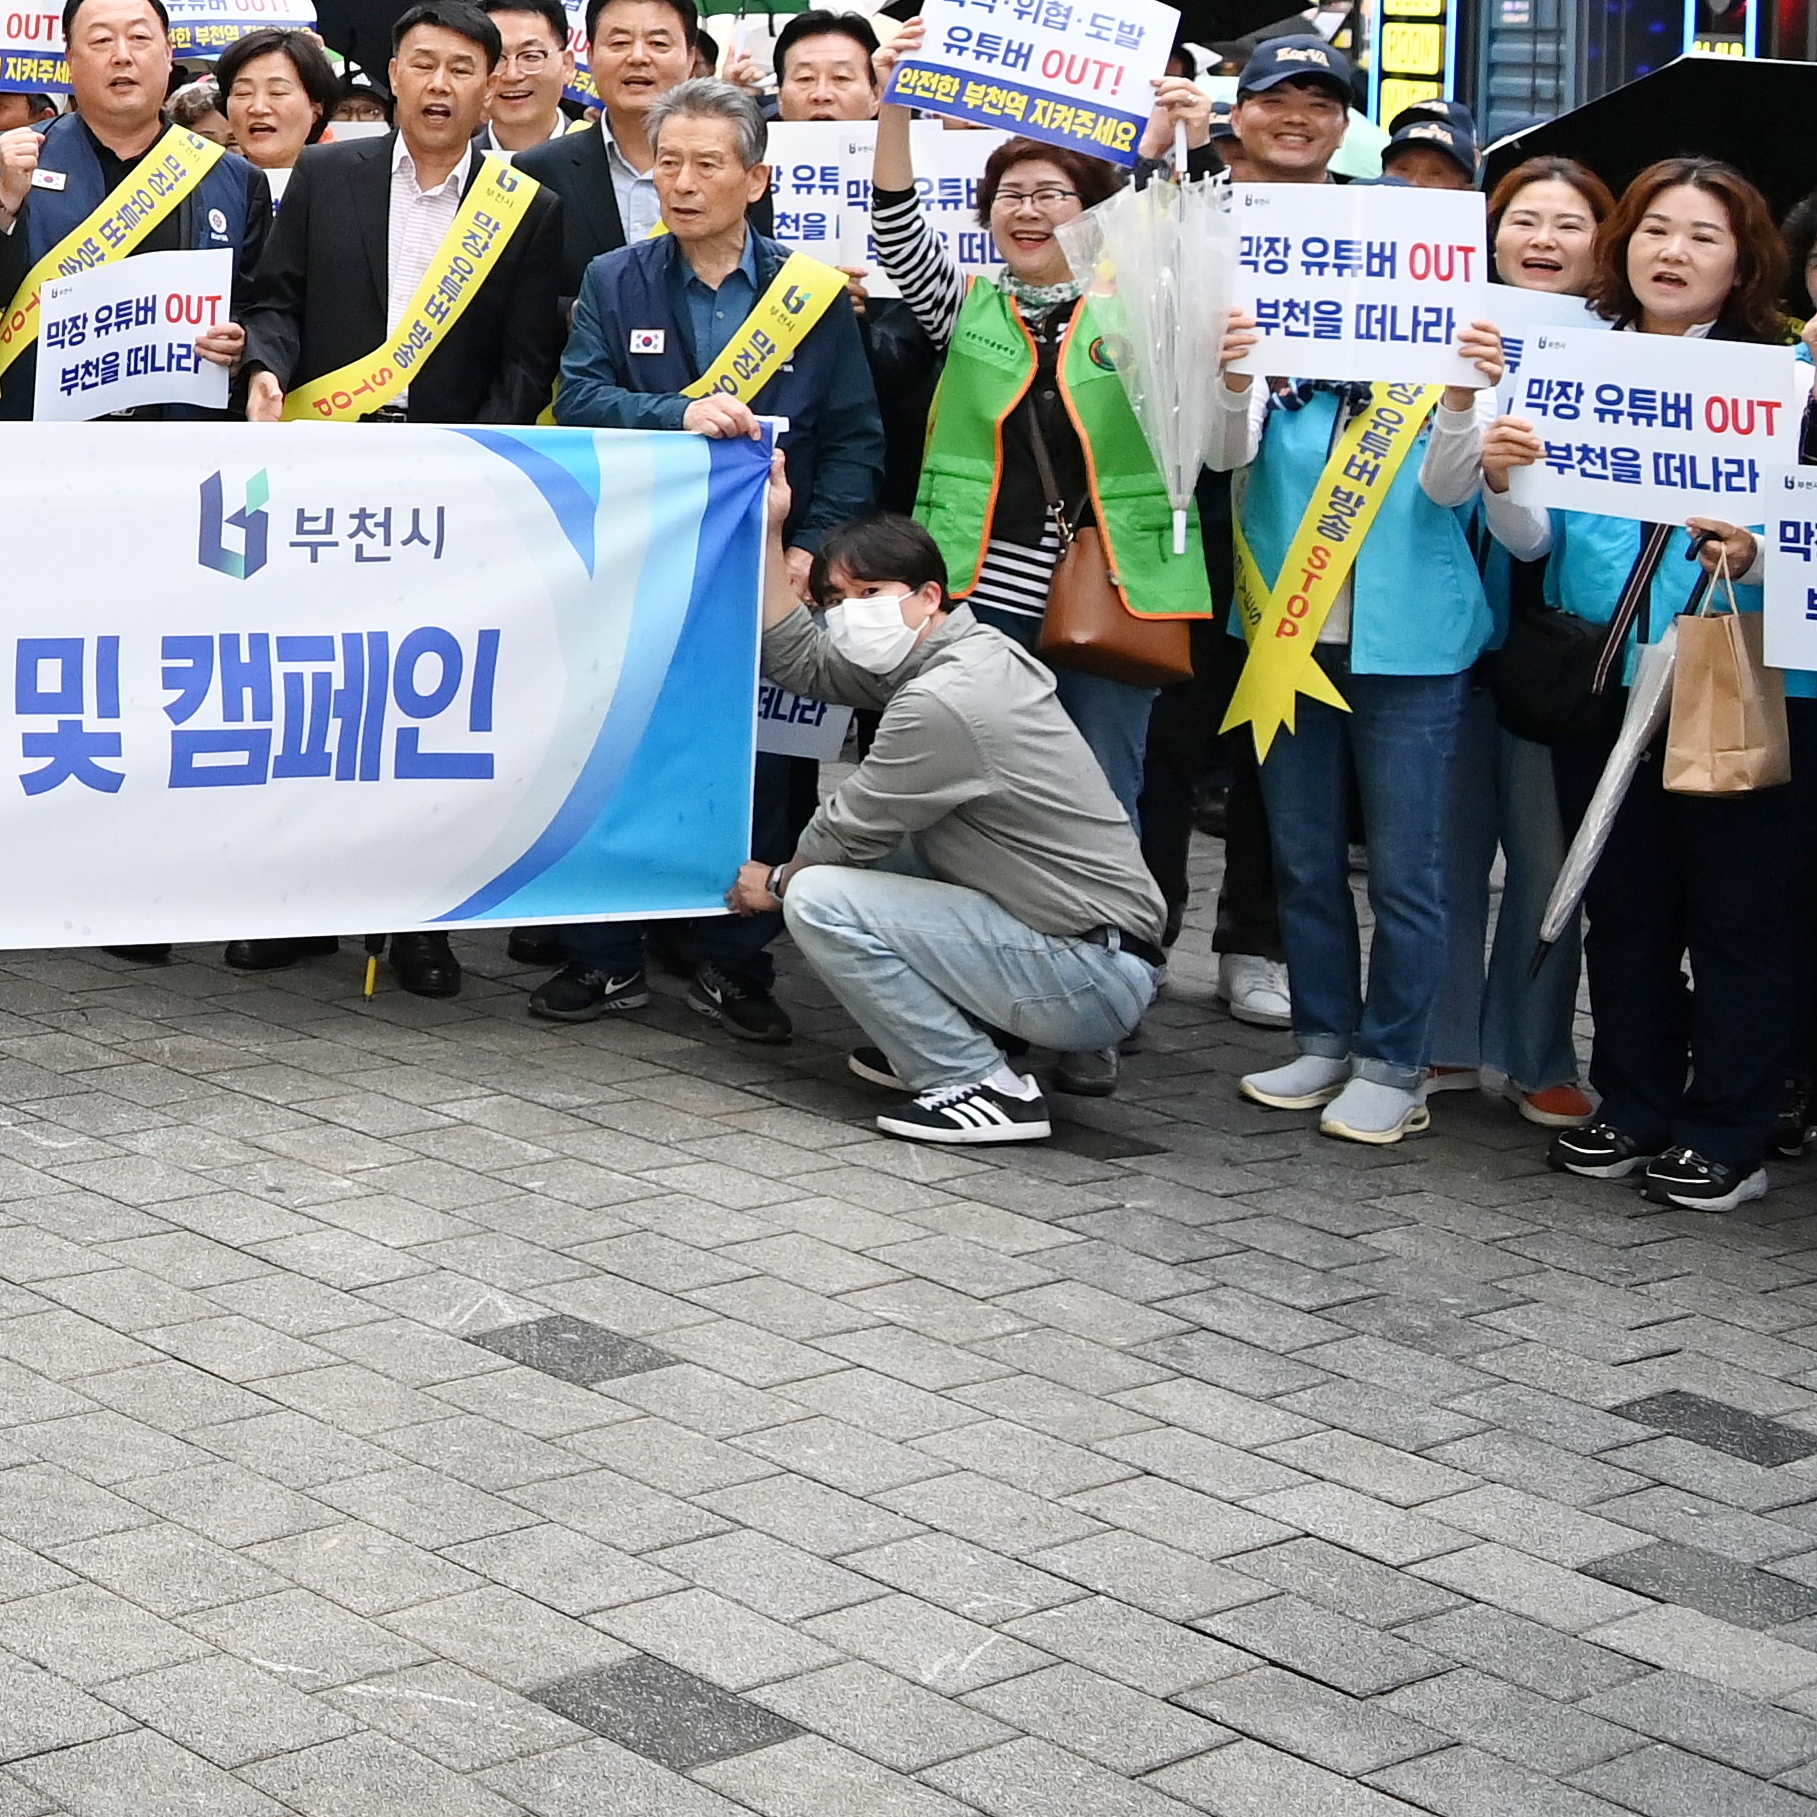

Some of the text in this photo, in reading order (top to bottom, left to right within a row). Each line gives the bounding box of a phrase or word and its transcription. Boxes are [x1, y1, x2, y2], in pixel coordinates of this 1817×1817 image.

[942, 26, 1124, 94] 유튜버 OUT!
[897, 69, 1136, 151] 안전한 부천역 지켜주세요
[1240, 236, 1476, 282] 막장 유튜버 OUT
[311, 210, 504, 417] 막장 유튜버 방송 STOP
[1256, 299, 1455, 344] 부천을 떠나라
[1525, 379, 1782, 436] 막장 유튜버 OUT
[1545, 441, 1759, 493] 부천을 떠나라
[290, 507, 444, 563] 부천시
[1275, 406, 1405, 640] 유튜버 방송 STOP
[16, 636, 125, 796] 및
[162, 627, 500, 788] 캠페인
